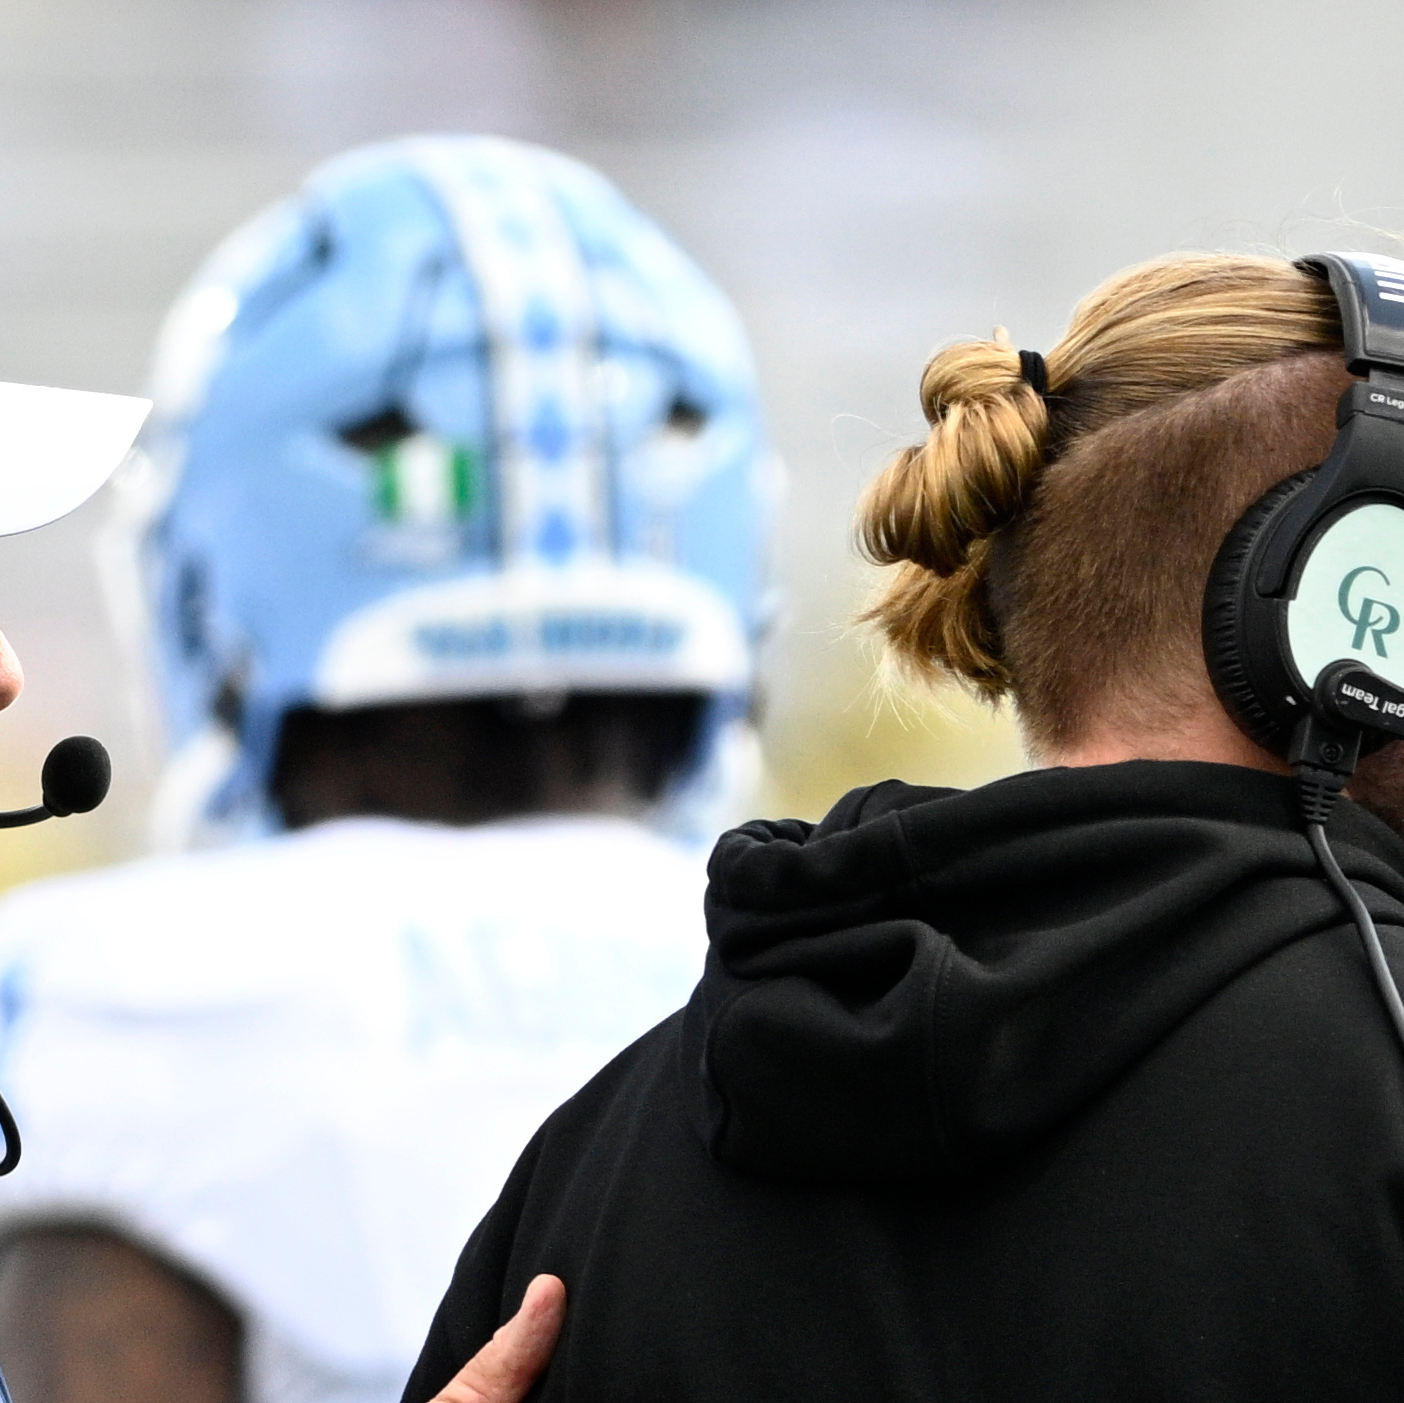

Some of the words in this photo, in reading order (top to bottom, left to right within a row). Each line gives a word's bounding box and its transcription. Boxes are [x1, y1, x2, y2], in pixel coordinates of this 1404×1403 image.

[1369, 393, 1386, 404] CR
[1337, 565, 1401, 659] CR
[1341, 683, 1380, 712] Team
